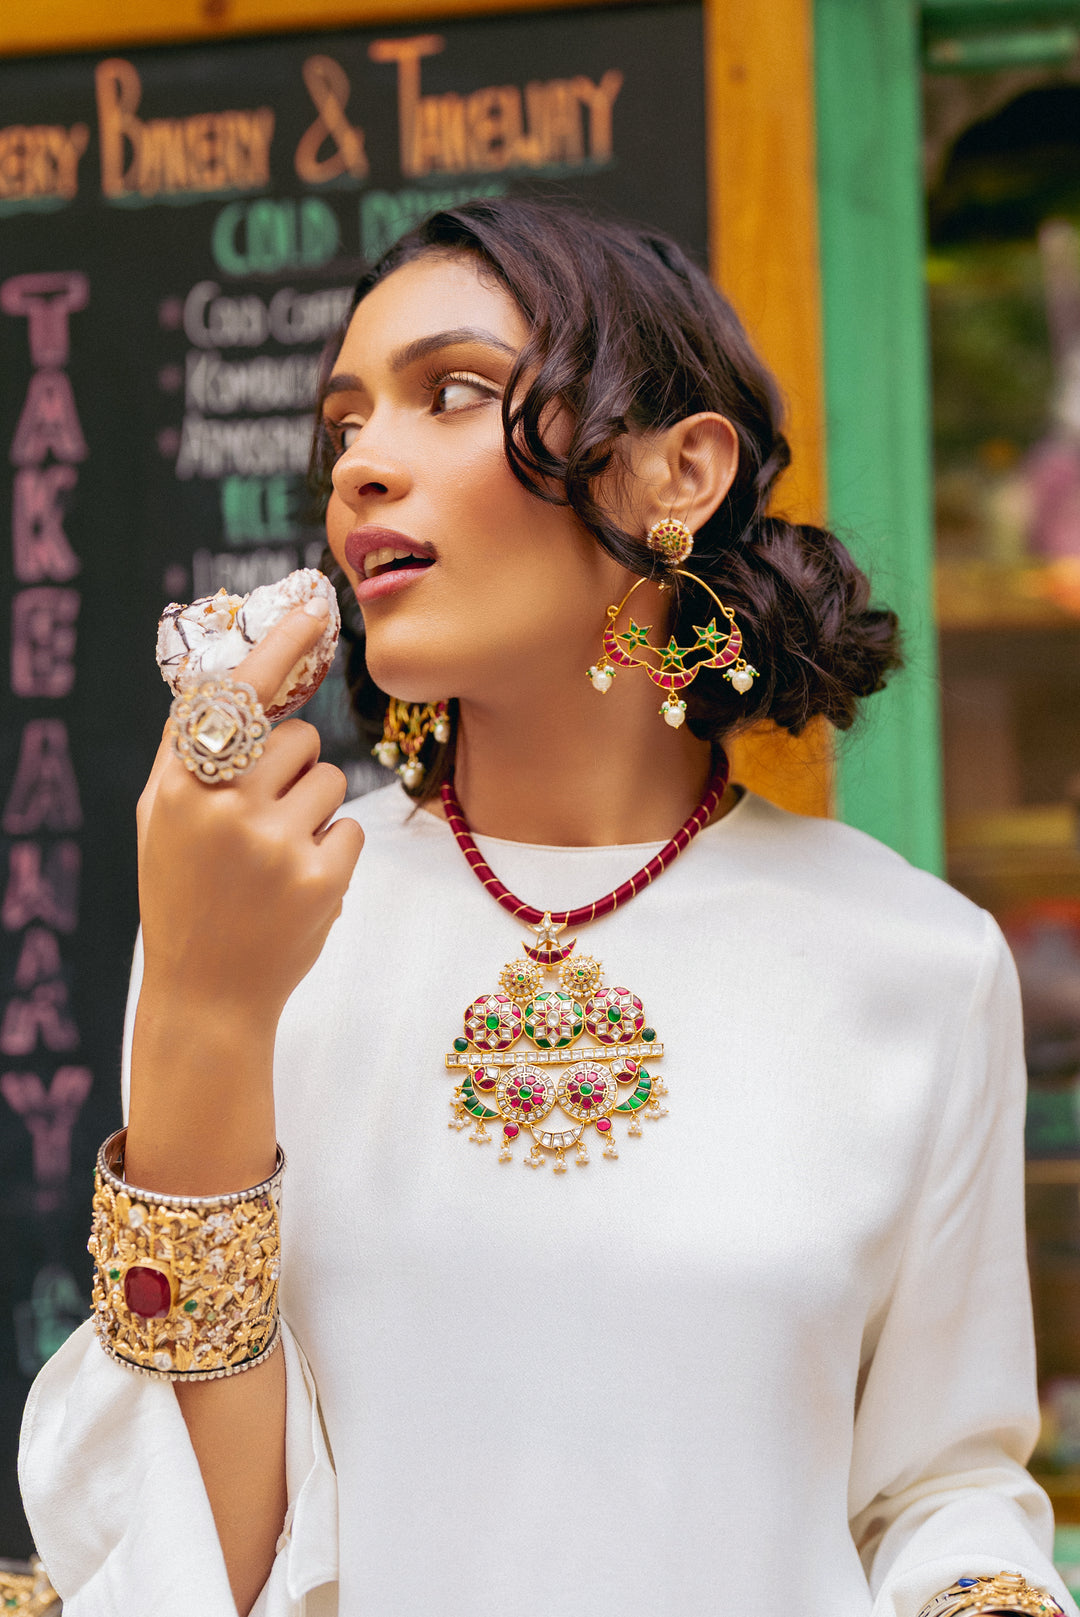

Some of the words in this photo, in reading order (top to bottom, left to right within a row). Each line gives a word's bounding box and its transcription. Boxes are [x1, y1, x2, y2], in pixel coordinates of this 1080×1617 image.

[95, 57, 274, 198] BAKERY
[294, 54, 371, 184] &
[211, 198, 341, 276] COLD
